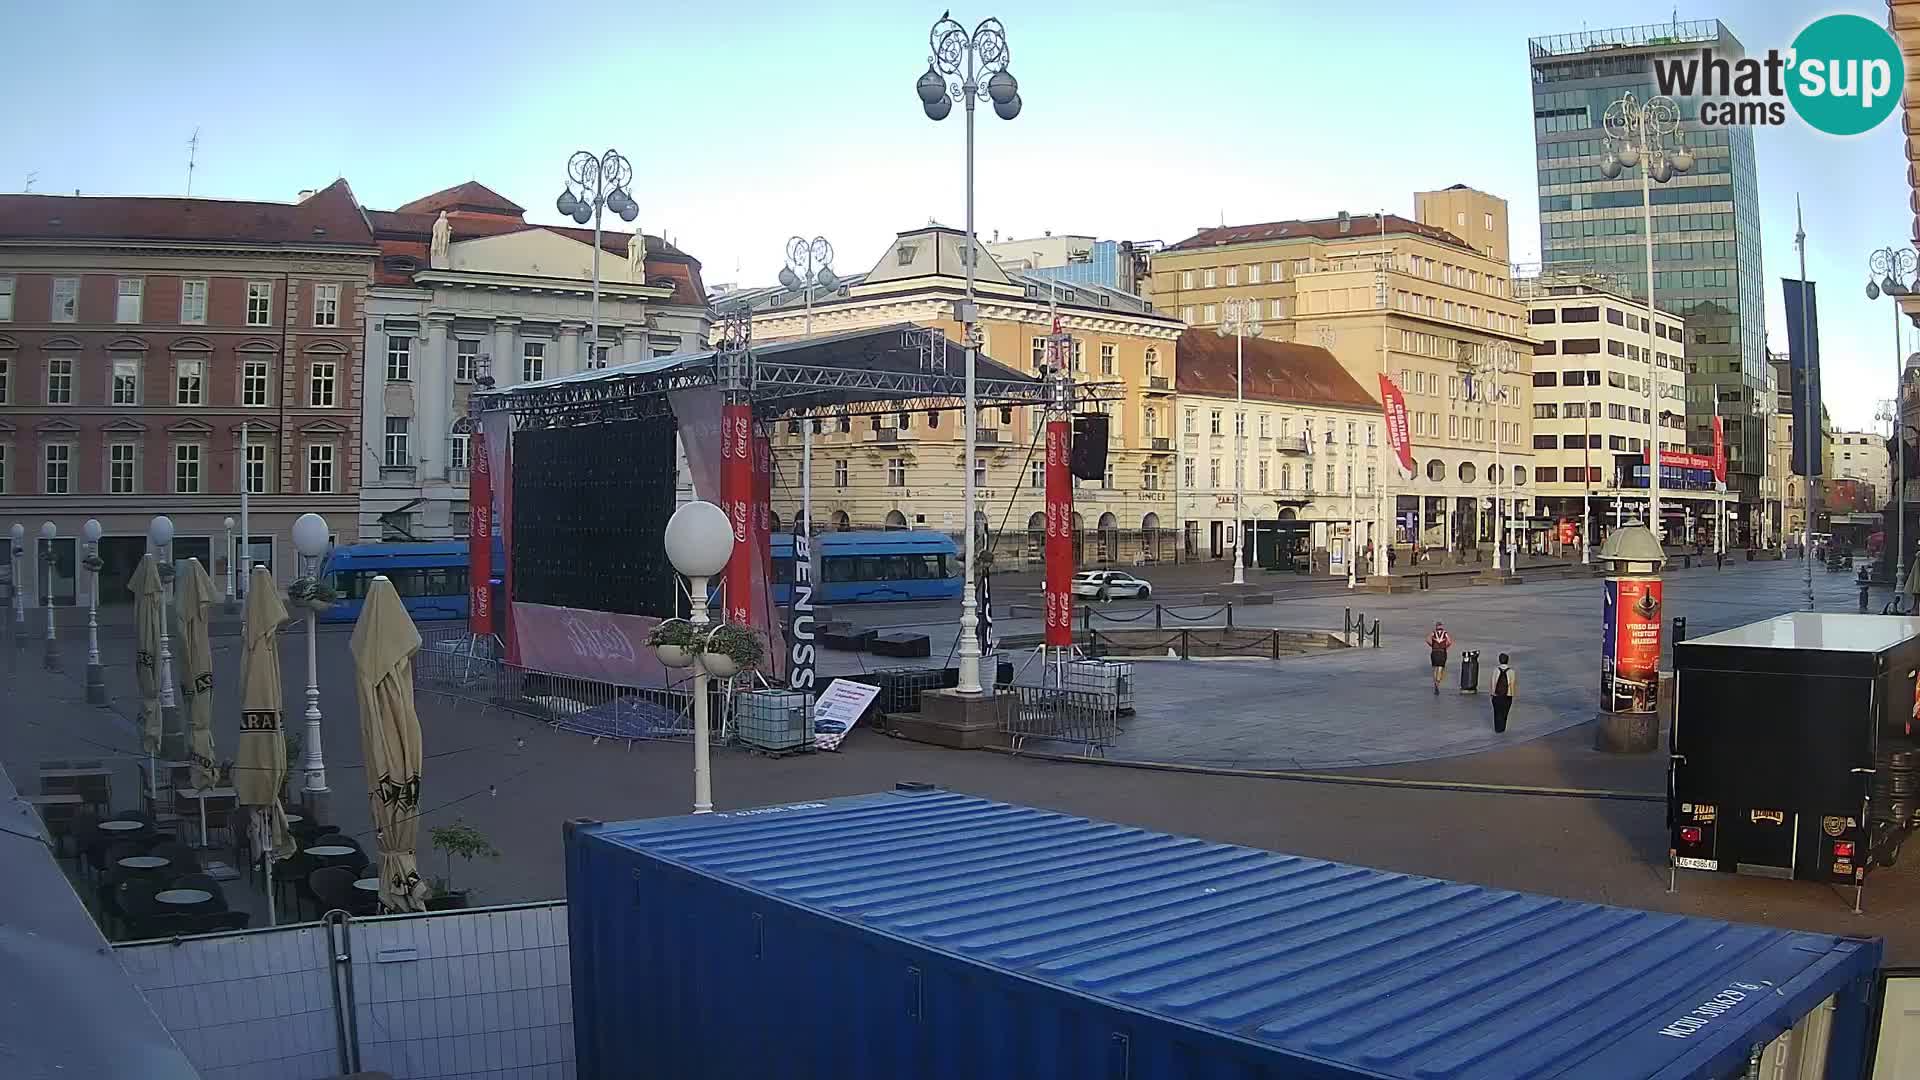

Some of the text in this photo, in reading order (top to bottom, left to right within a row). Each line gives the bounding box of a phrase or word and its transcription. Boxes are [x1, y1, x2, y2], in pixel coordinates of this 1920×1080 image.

[1694, 804, 1714, 814] ZUJA
[1692, 989, 1747, 1018] 300629
[1735, 981, 1759, 990] 6
